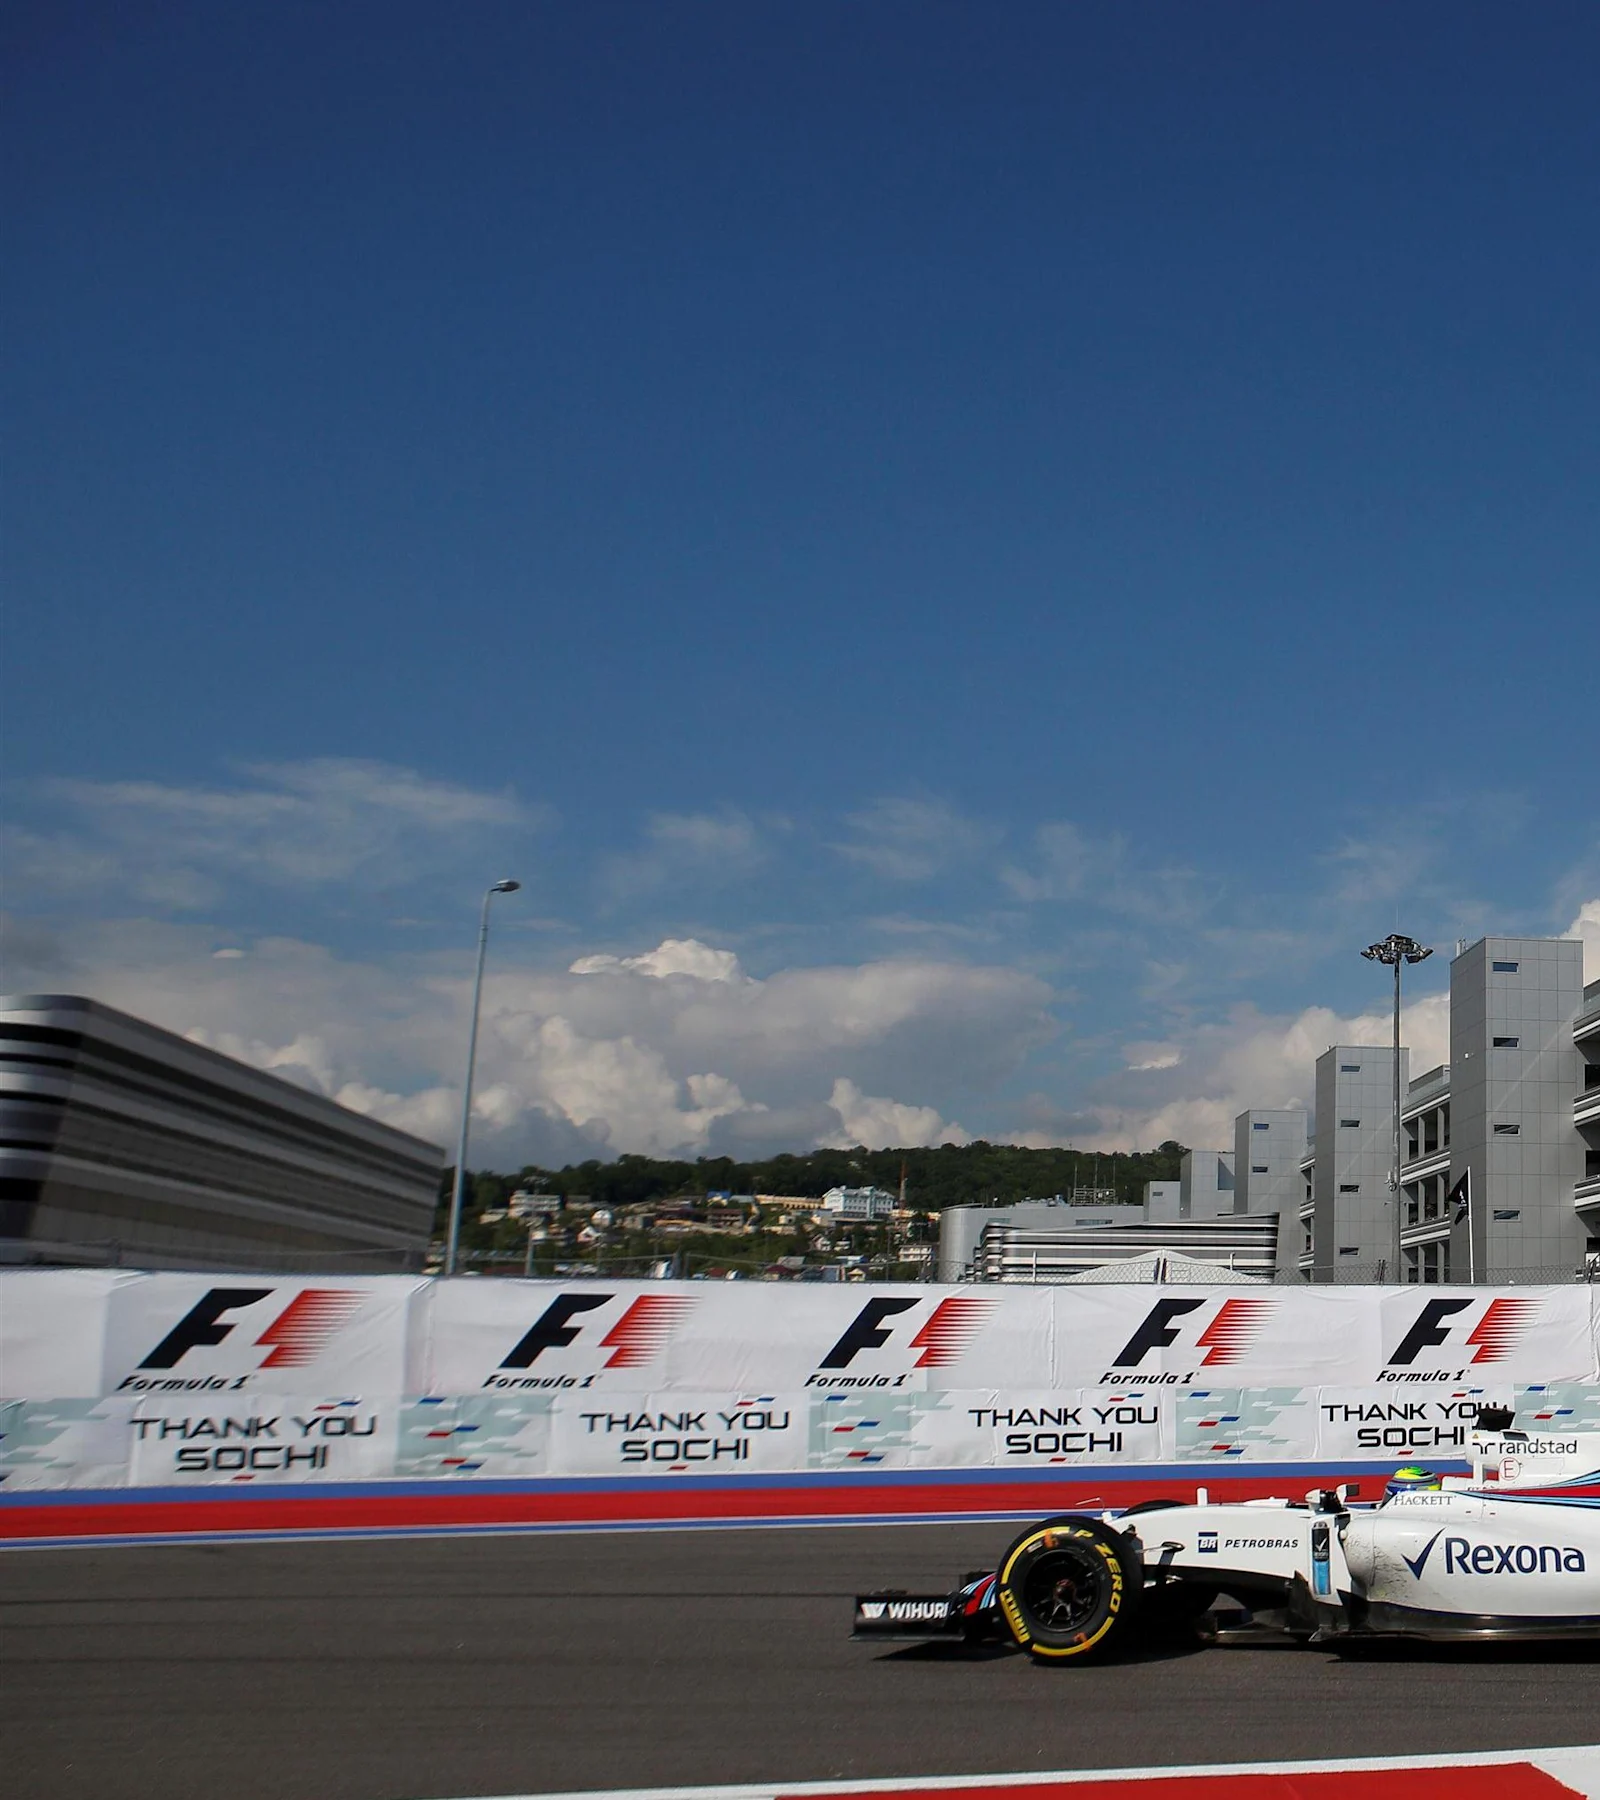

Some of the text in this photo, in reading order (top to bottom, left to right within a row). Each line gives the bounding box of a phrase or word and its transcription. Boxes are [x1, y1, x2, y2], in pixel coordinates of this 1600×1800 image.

[114, 1375, 250, 1391] Formula 1
[482, 1375, 596, 1388] Formula 1
[804, 1373, 907, 1387] Formula 1
[1099, 1371, 1195, 1384] Formula 1
[1375, 1369, 1465, 1381] Formula 1
[969, 1406, 1158, 1427] THANK YOU
[1321, 1403, 1427, 1421] THANK
[128, 1415, 377, 1439] THANK YOU
[580, 1412, 789, 1432] THANK YOU
[1005, 1431, 1121, 1454] SOCHI
[1357, 1425, 1464, 1447] SOCHI
[621, 1438, 749, 1462] SOCHI
[1499, 1440, 1577, 1454] randstad
[175, 1445, 328, 1473] SOCHI
[1224, 1539, 1299, 1549] PETROBRAS
[1445, 1537, 1586, 1574] Rexona
[1074, 1528, 1122, 1614] P ZERO
[888, 1602, 949, 1619] WIHURI
